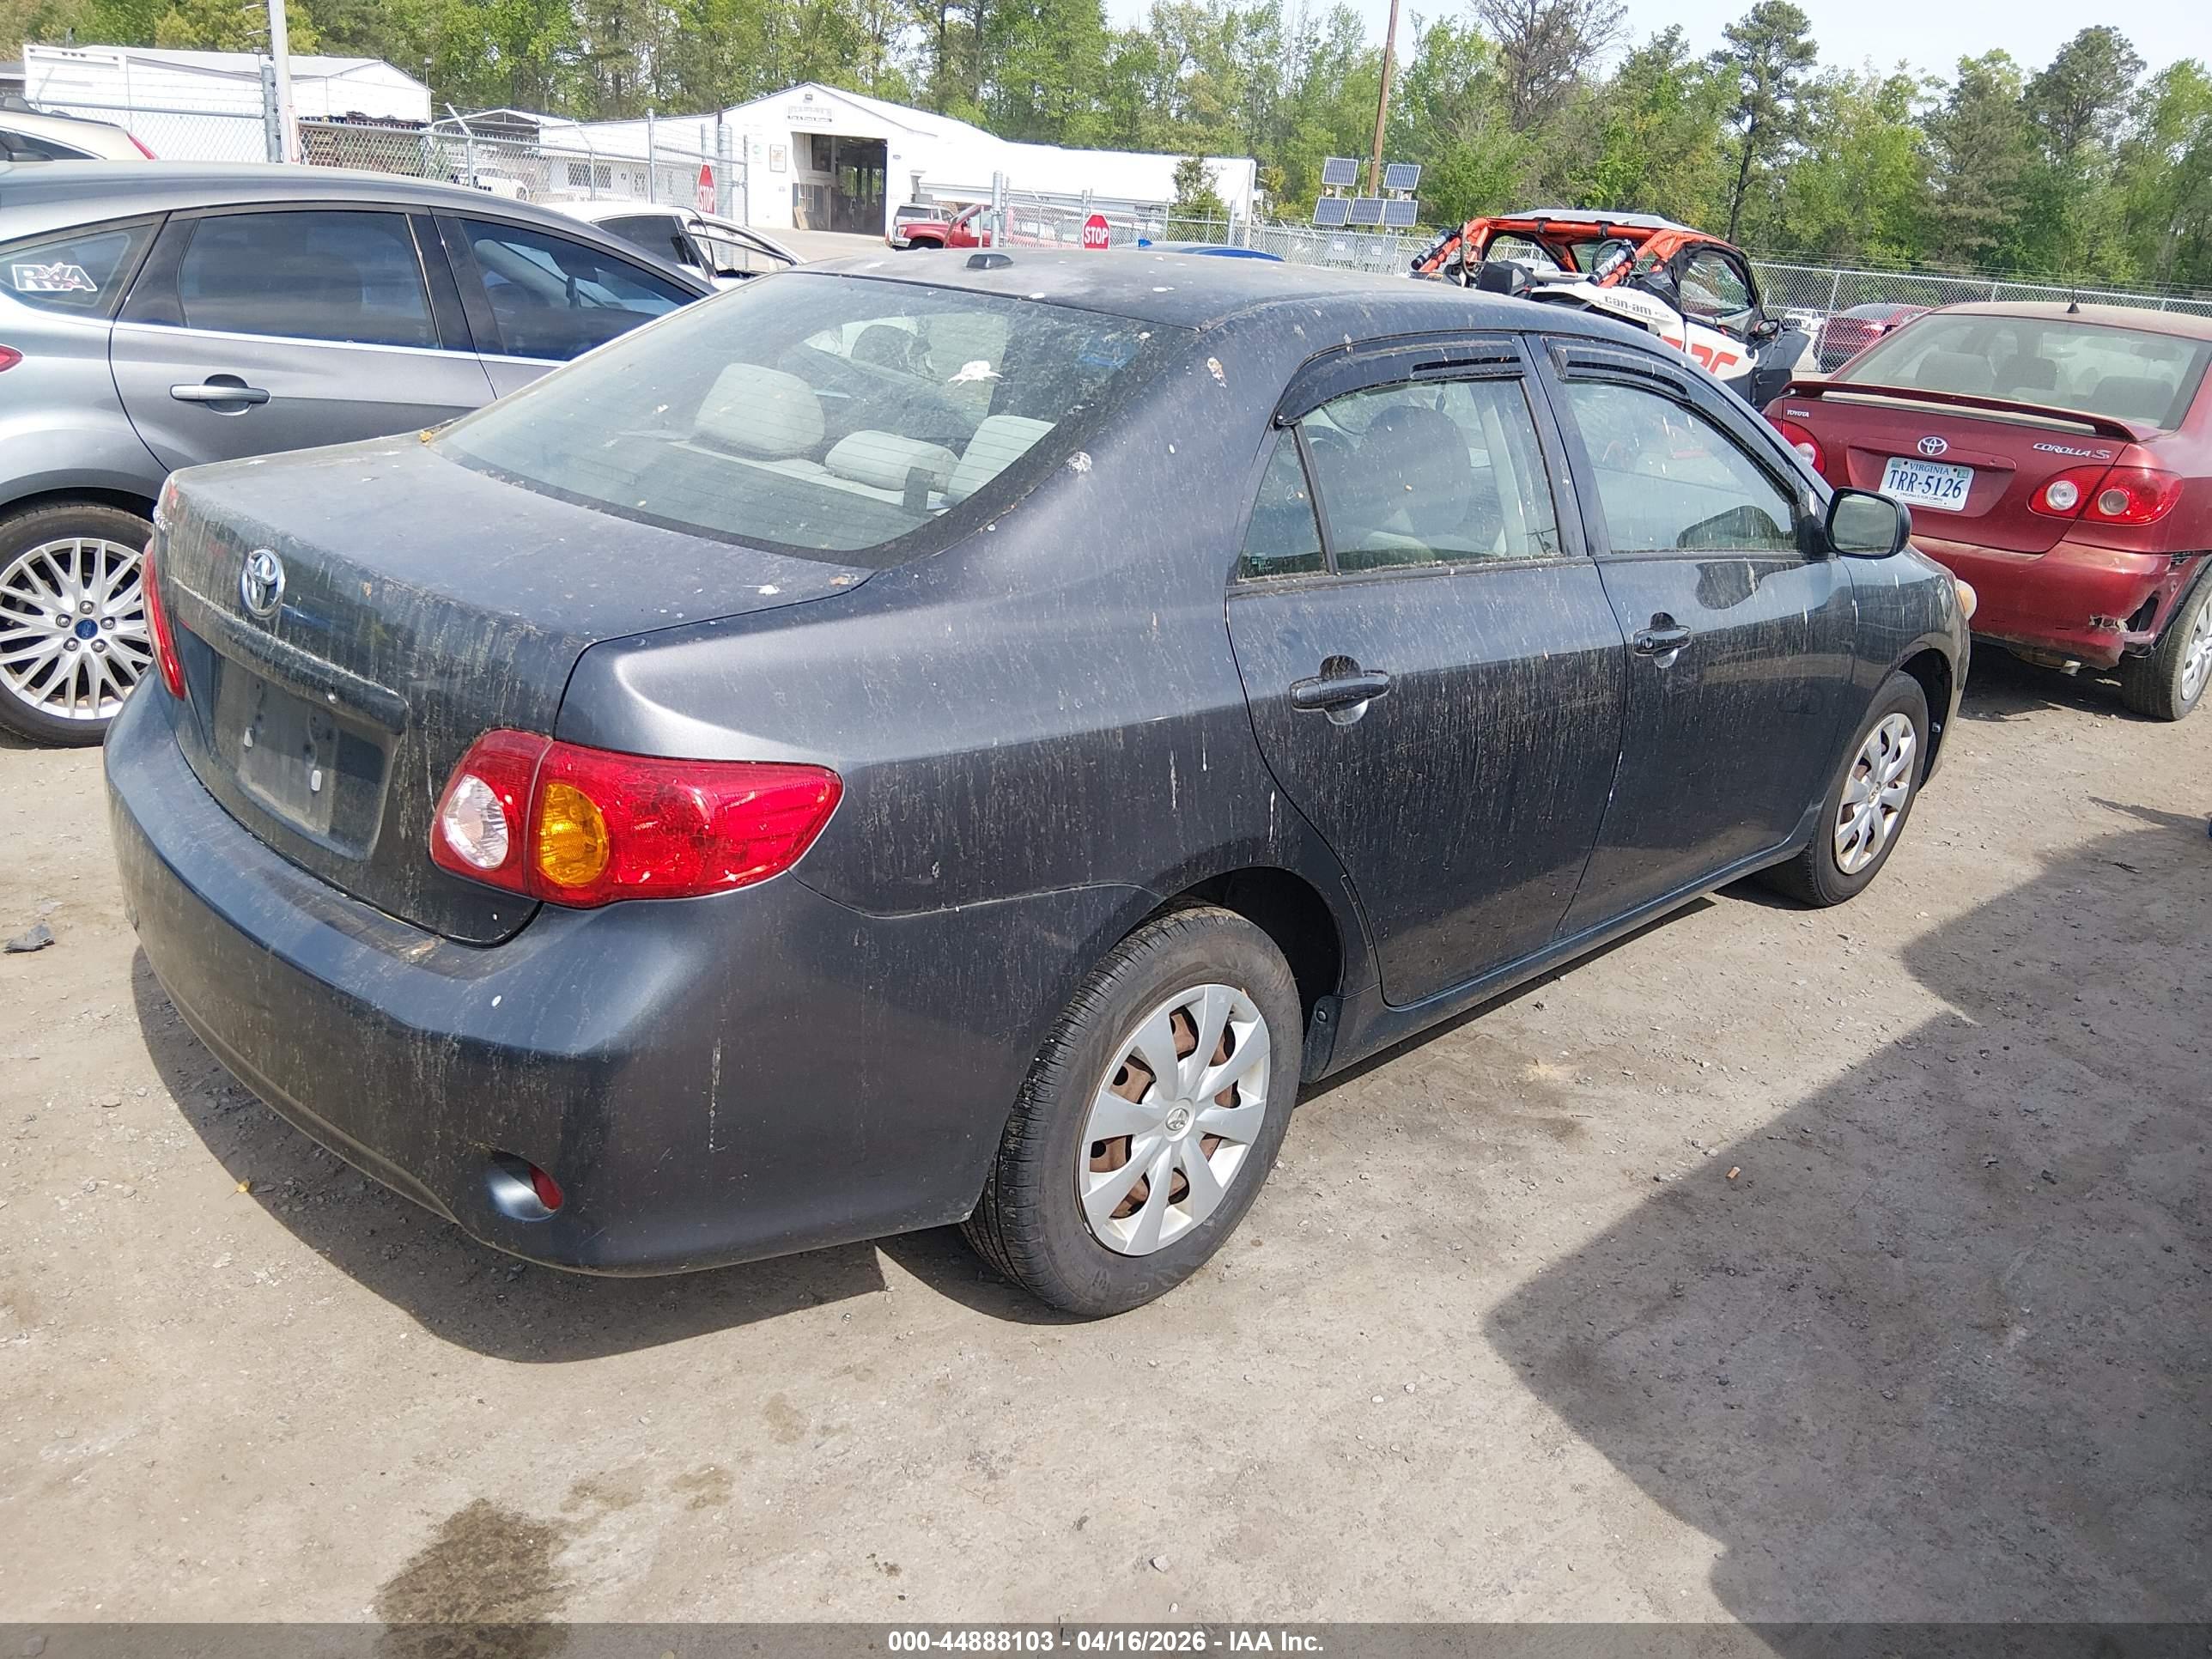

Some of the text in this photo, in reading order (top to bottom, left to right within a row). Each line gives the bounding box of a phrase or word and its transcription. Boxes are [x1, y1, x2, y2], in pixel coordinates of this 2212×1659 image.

[699, 185, 714, 213] STOP
[1084, 226, 1109, 244] STOP
[1604, 295, 1652, 315] can-am
[2033, 442, 2112, 459] COROLLA S
[1910, 463, 1949, 475] VIRGINIA
[1888, 470, 1965, 498] TRR-5126
